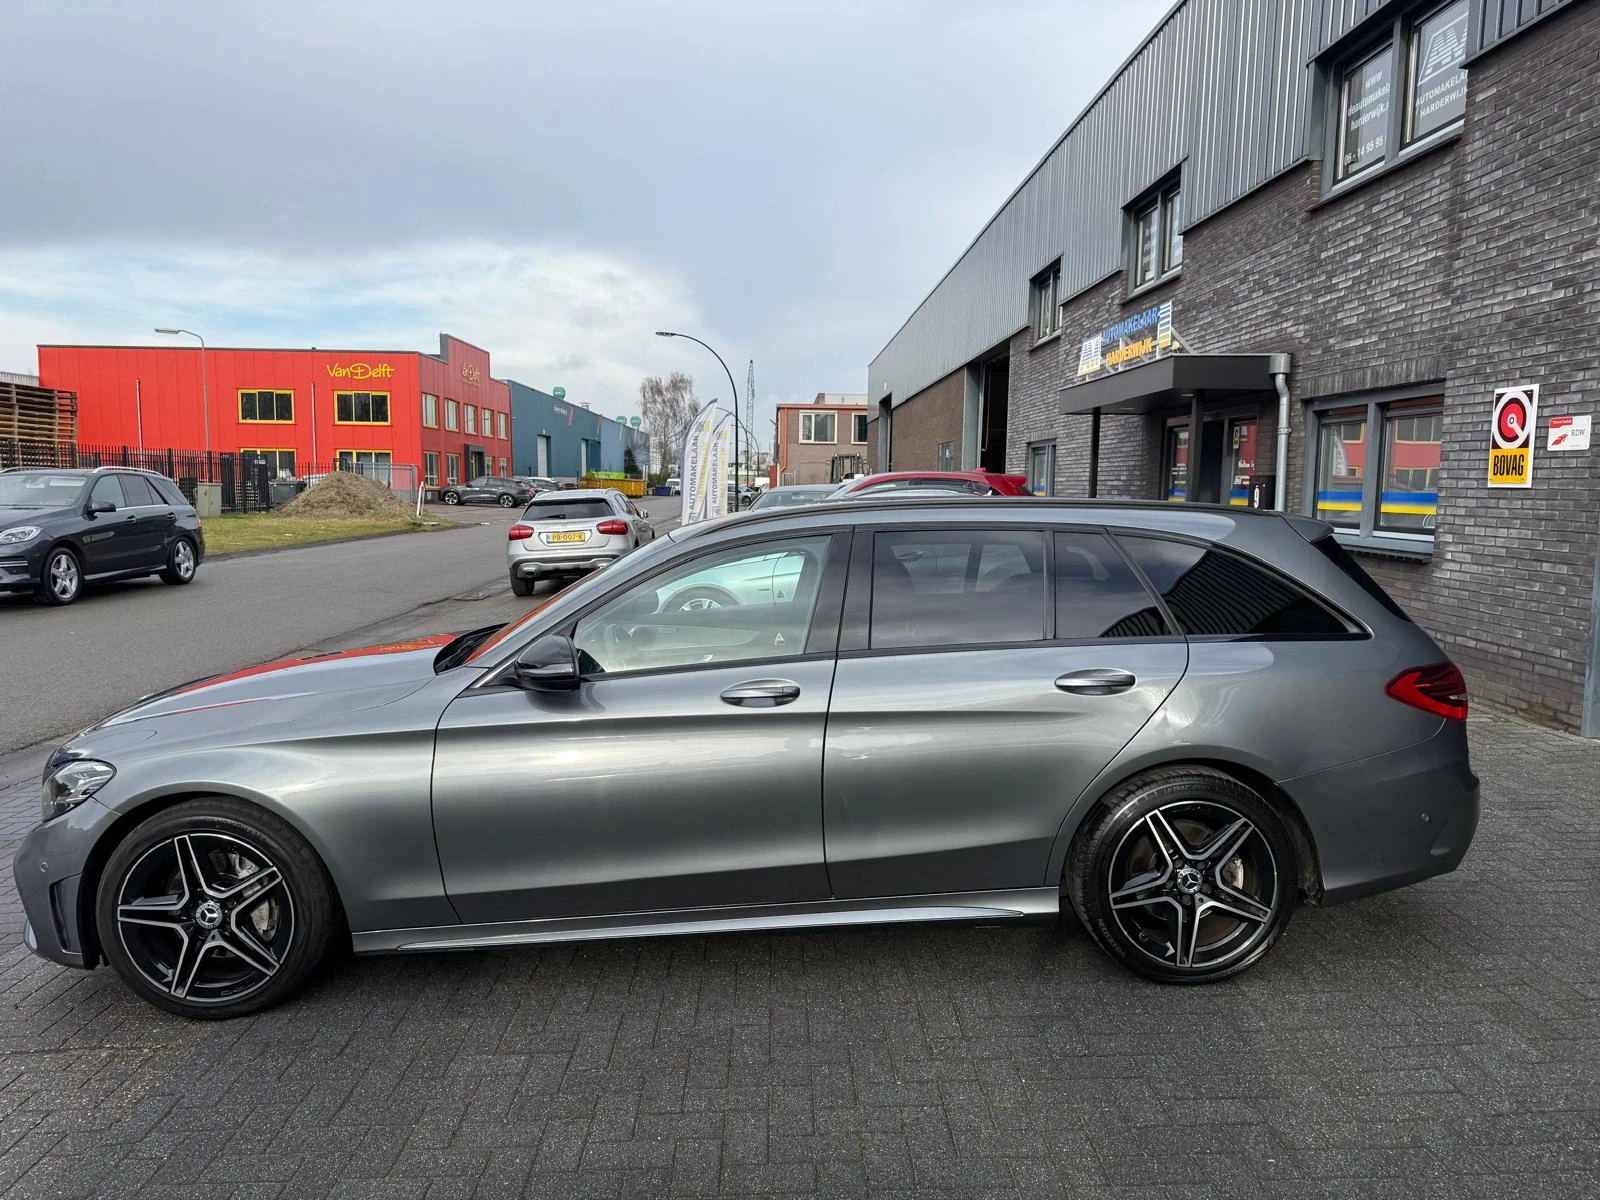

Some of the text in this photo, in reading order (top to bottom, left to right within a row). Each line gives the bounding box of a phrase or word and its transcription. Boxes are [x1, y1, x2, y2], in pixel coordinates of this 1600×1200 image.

[1101, 306, 1159, 345] AUTOMAKELAAR
[1105, 336, 1153, 367] HARDERWIJK
[688, 434, 700, 511] AUTOMAKELAAR
[711, 442, 719, 505] AUTOMAKELAAR
[1493, 454, 1525, 477] BOVAG
[1253, 487, 1260, 509] 9
